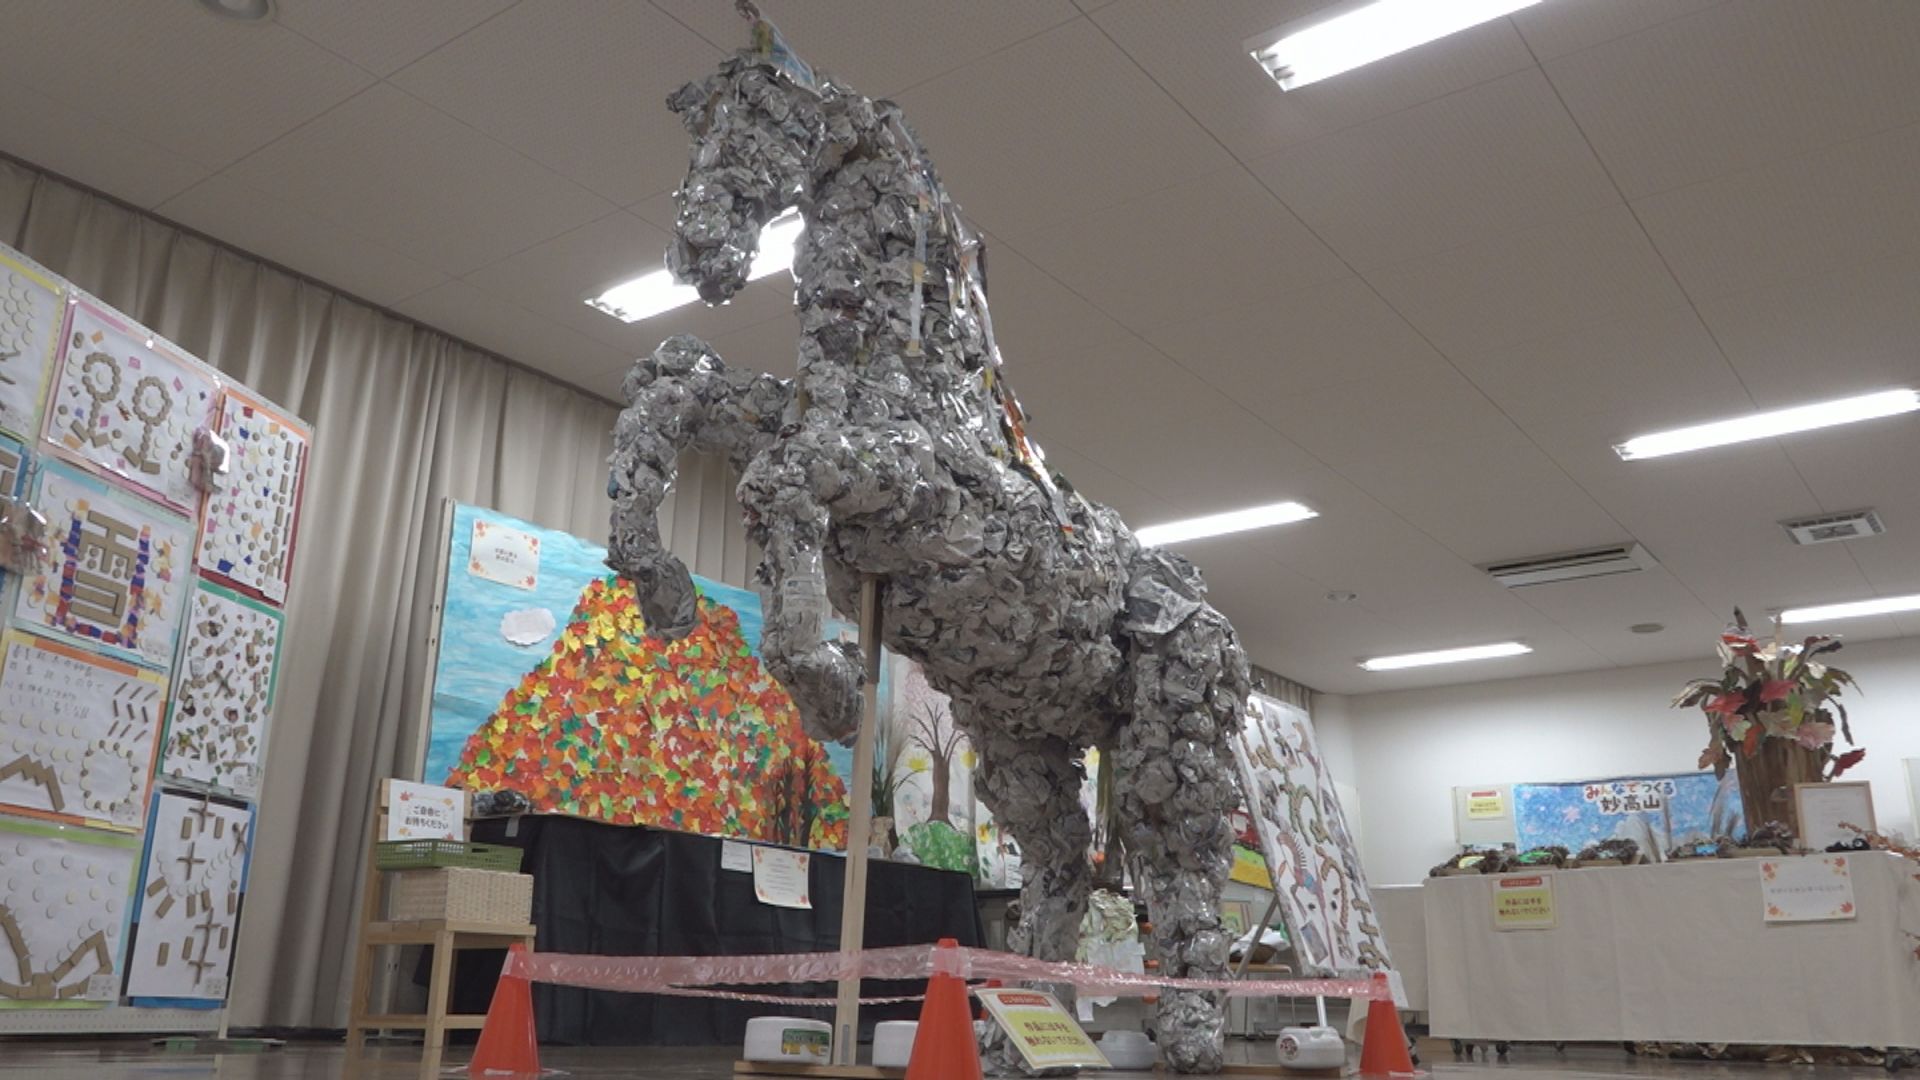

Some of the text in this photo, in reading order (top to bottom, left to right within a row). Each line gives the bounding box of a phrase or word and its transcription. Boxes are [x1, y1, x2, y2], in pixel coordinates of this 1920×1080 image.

[1585, 782, 1674, 800] みんなでつくる
[1601, 794, 1660, 812] 妙高山
